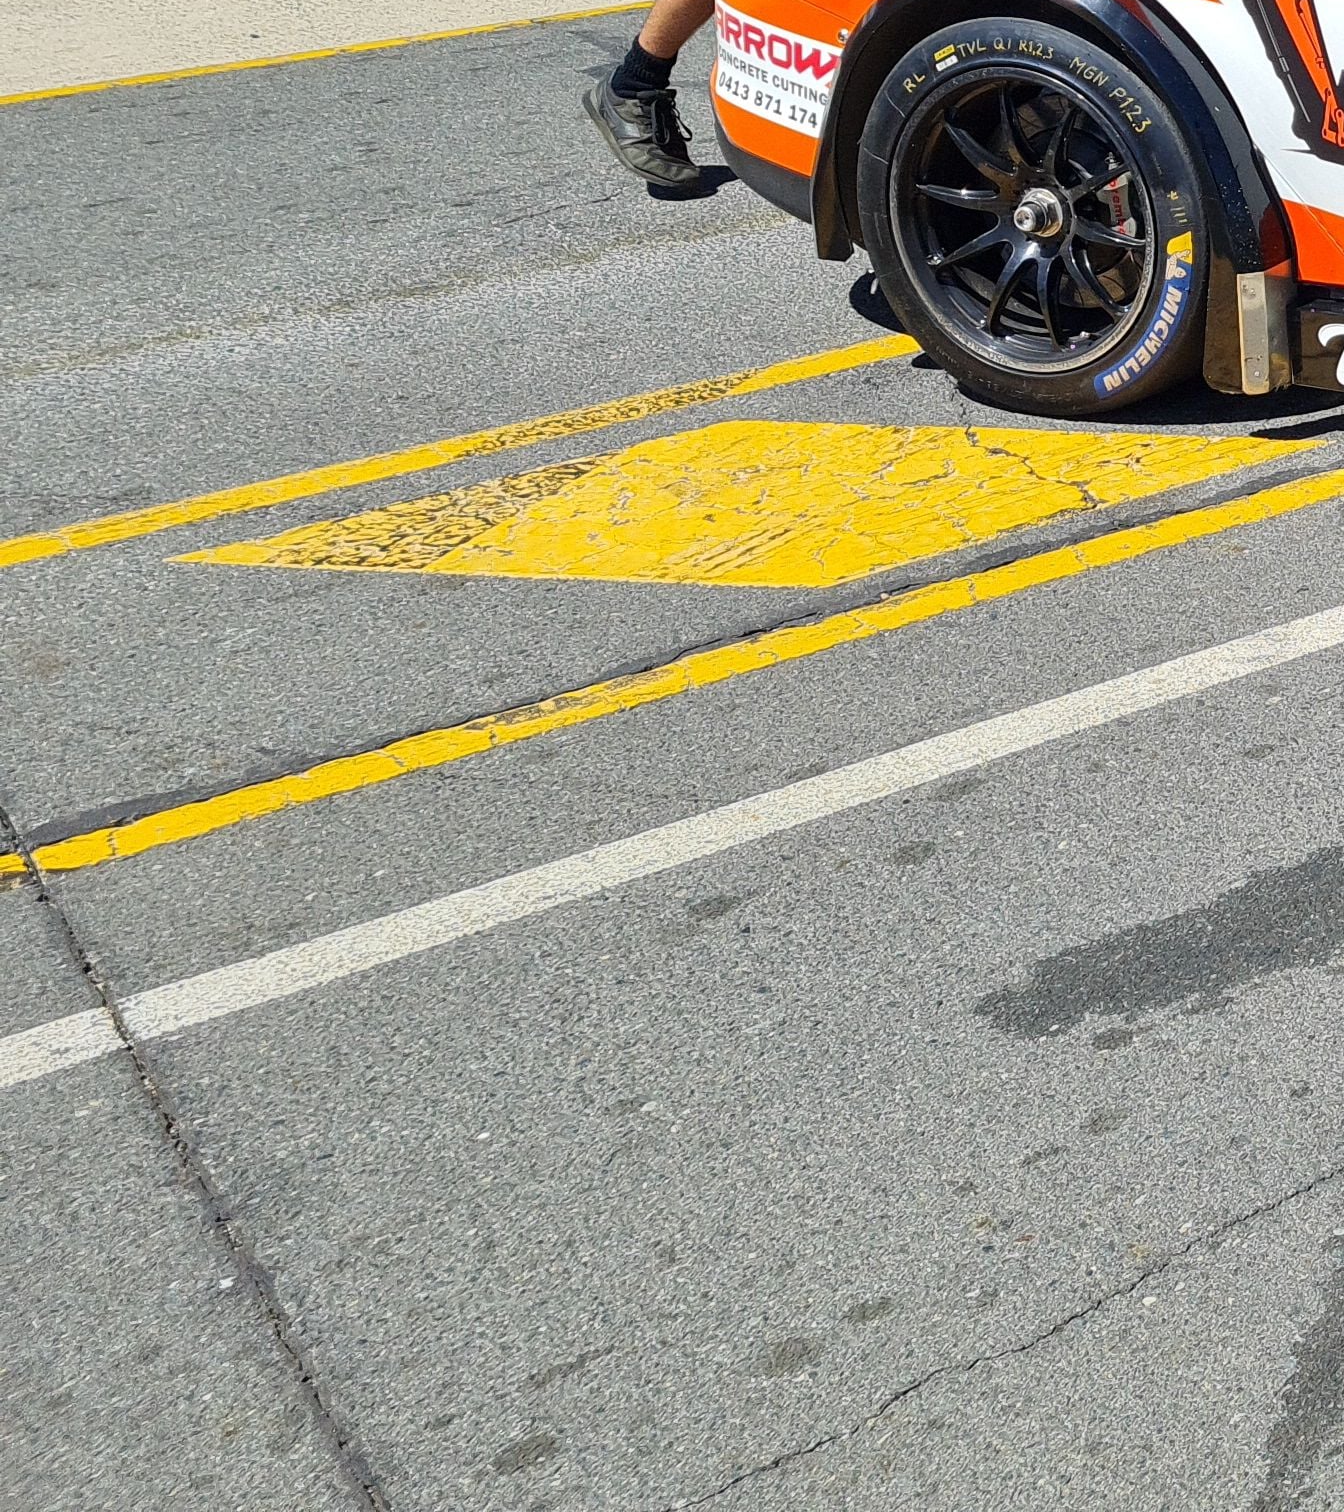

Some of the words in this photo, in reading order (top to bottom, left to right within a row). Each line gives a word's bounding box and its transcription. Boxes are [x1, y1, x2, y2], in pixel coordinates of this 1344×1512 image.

[715, 3, 842, 80] ARROW
[956, 39, 988, 58] TVL
[718, 45, 769, 84] CONCRETE
[772, 74, 829, 106] CUTTING
[719, 71, 750, 100] 0413
[753, 90, 783, 116] 871
[788, 104, 818, 129] 174
[903, 72, 926, 94] RL
[1068, 56, 1110, 87] MGN
[1102, 285, 1184, 392] MICHELIN
